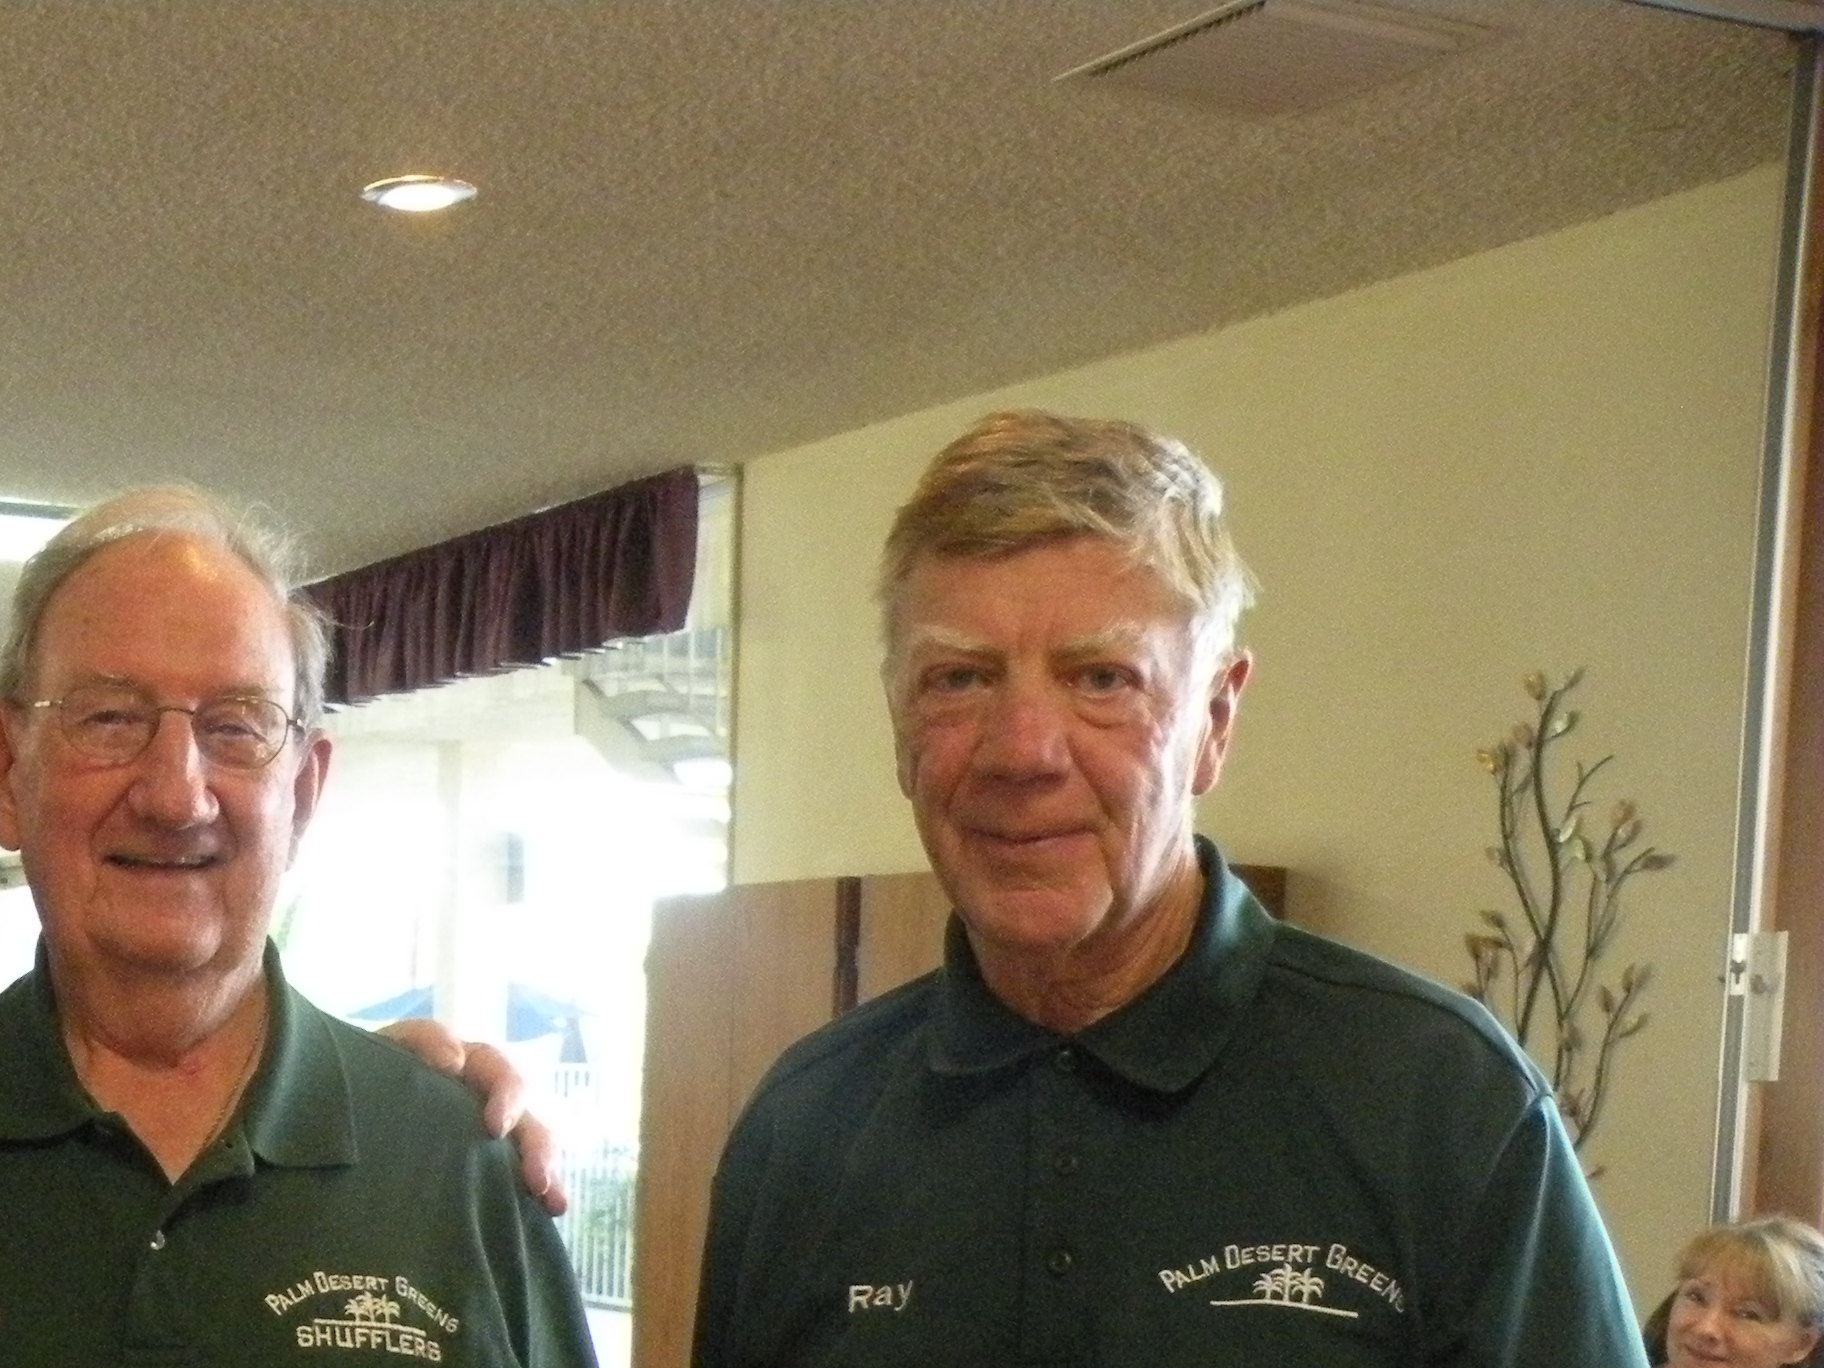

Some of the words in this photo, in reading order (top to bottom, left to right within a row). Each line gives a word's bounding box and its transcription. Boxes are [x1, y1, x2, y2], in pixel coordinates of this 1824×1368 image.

[1158, 1255, 1220, 1293] PALM
[1224, 1244, 1321, 1270] DESERT
[264, 1279, 315, 1316] PALM
[313, 1271, 389, 1293] DESERT
[395, 1276, 459, 1333] GREENS
[848, 1280, 913, 1313] Ray
[296, 1325, 442, 1362] SHUFFLERS
